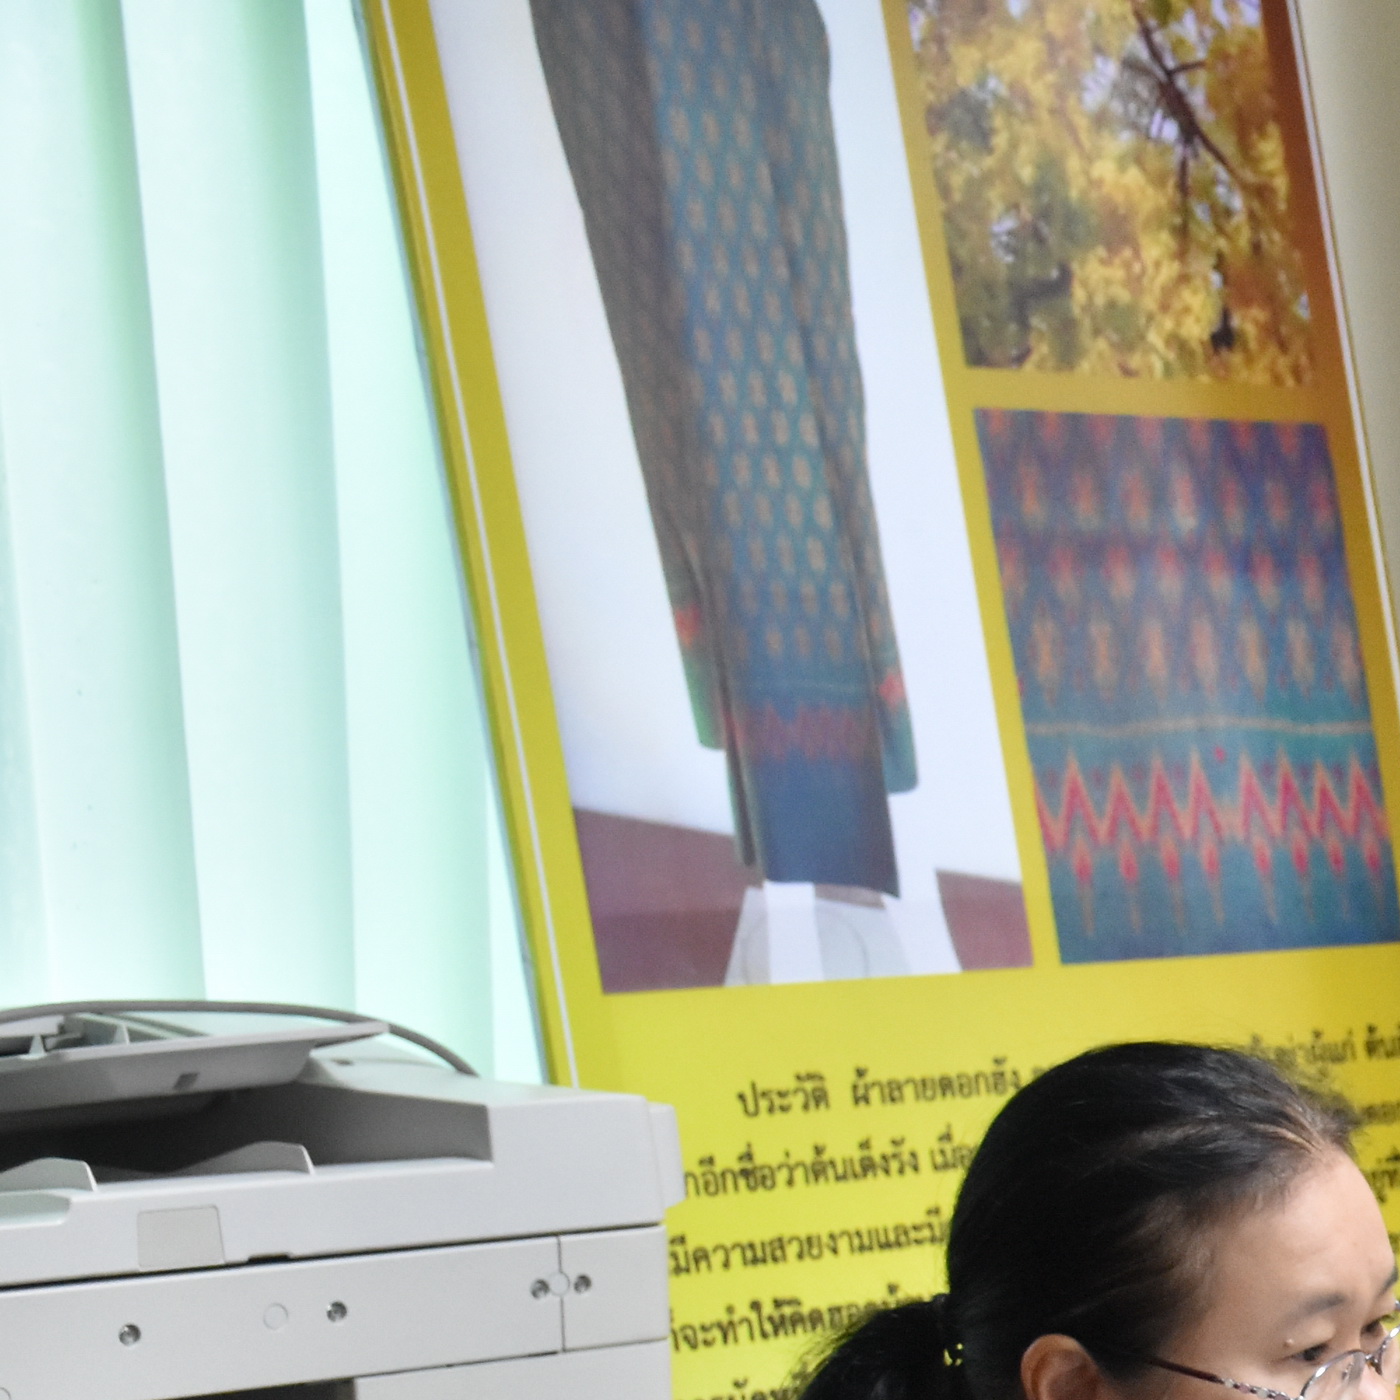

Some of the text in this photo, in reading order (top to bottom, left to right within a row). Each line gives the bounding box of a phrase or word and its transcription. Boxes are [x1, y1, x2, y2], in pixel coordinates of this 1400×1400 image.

[737, 1071, 831, 1118] ประวัติ
[684, 1136, 919, 1197] กอีกชื่อว่าต้นเต็งรัง
[928, 1121, 980, 1173] เมื่อ
[669, 1206, 950, 1277] มีความสวยงามและมี
